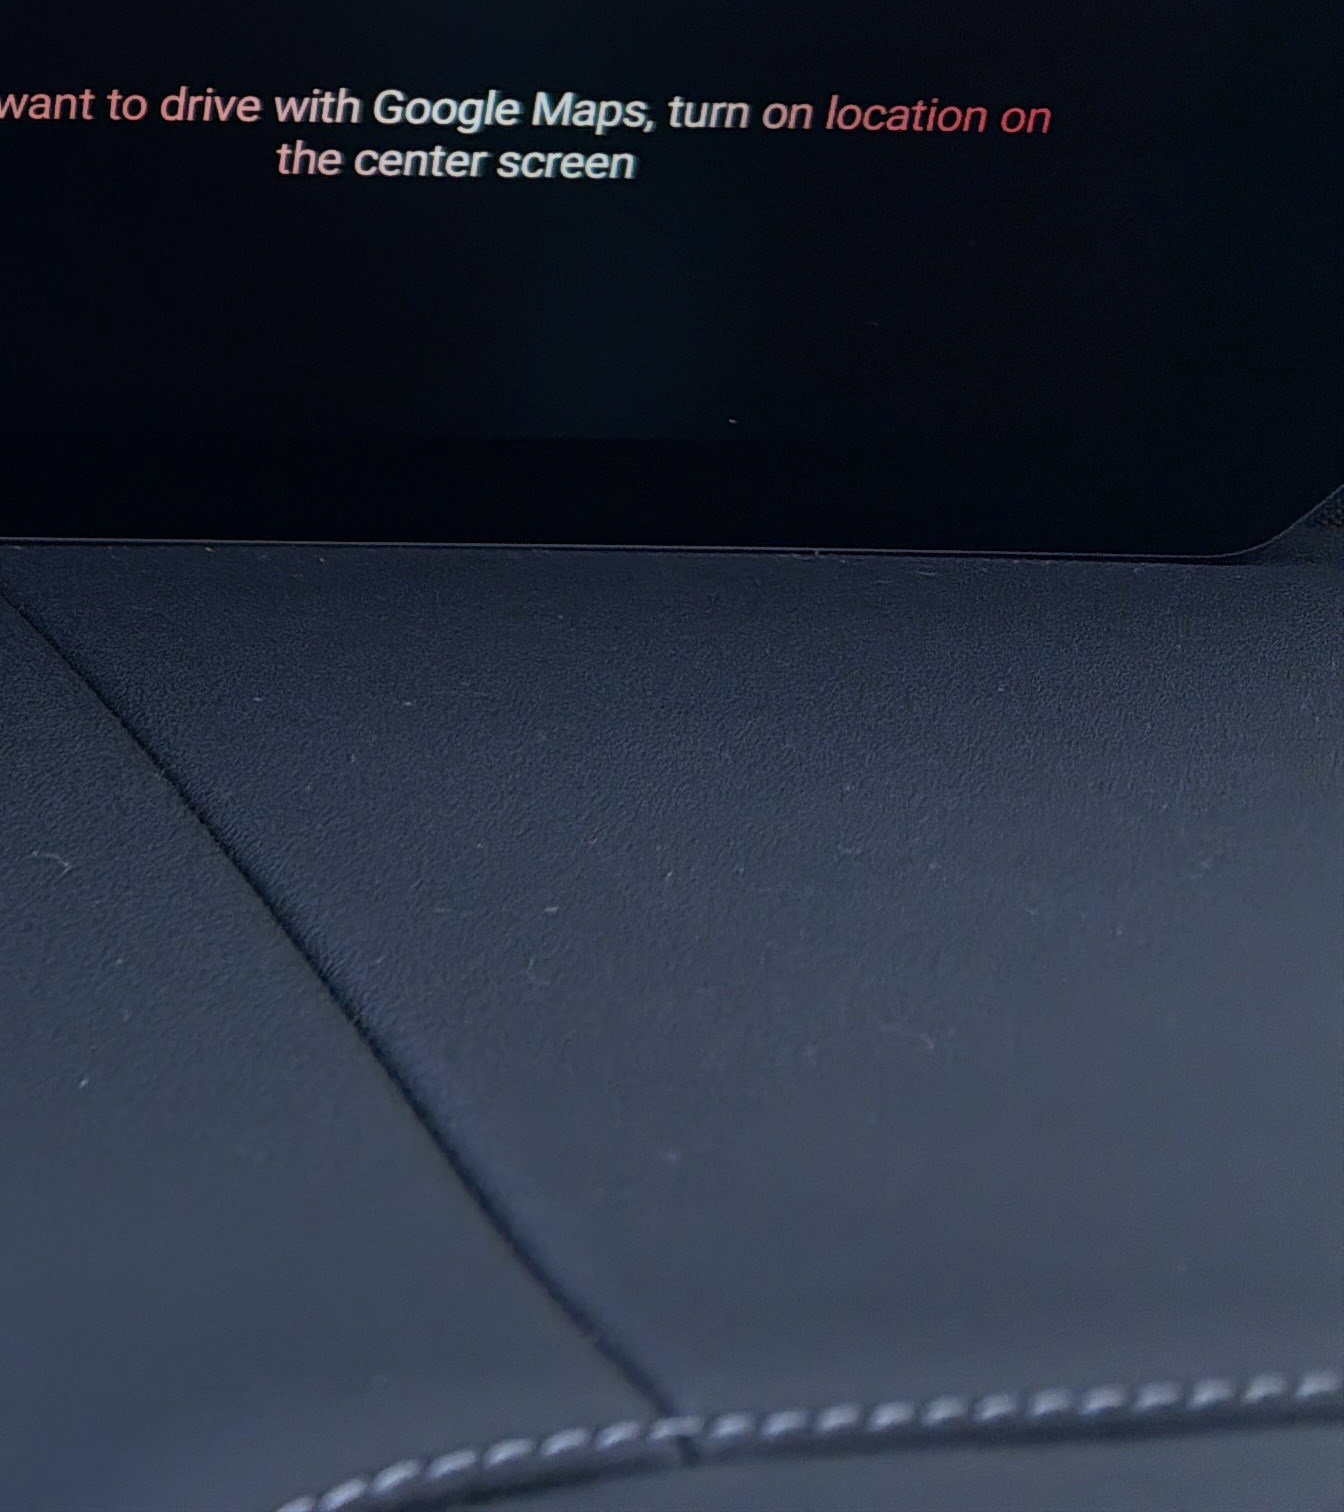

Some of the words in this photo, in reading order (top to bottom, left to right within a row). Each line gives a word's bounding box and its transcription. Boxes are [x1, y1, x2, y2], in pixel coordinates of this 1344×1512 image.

[108, 91, 149, 122] to
[160, 87, 263, 123] drive
[275, 90, 362, 125] with
[374, 90, 521, 134] Google
[532, 93, 656, 134] Maps,
[668, 96, 750, 129] turn
[762, 101, 814, 130] on
[825, 95, 989, 133] location
[1001, 104, 1053, 134] on
[277, 141, 343, 176] the
[354, 144, 490, 179] center
[497, 148, 638, 181] screen
